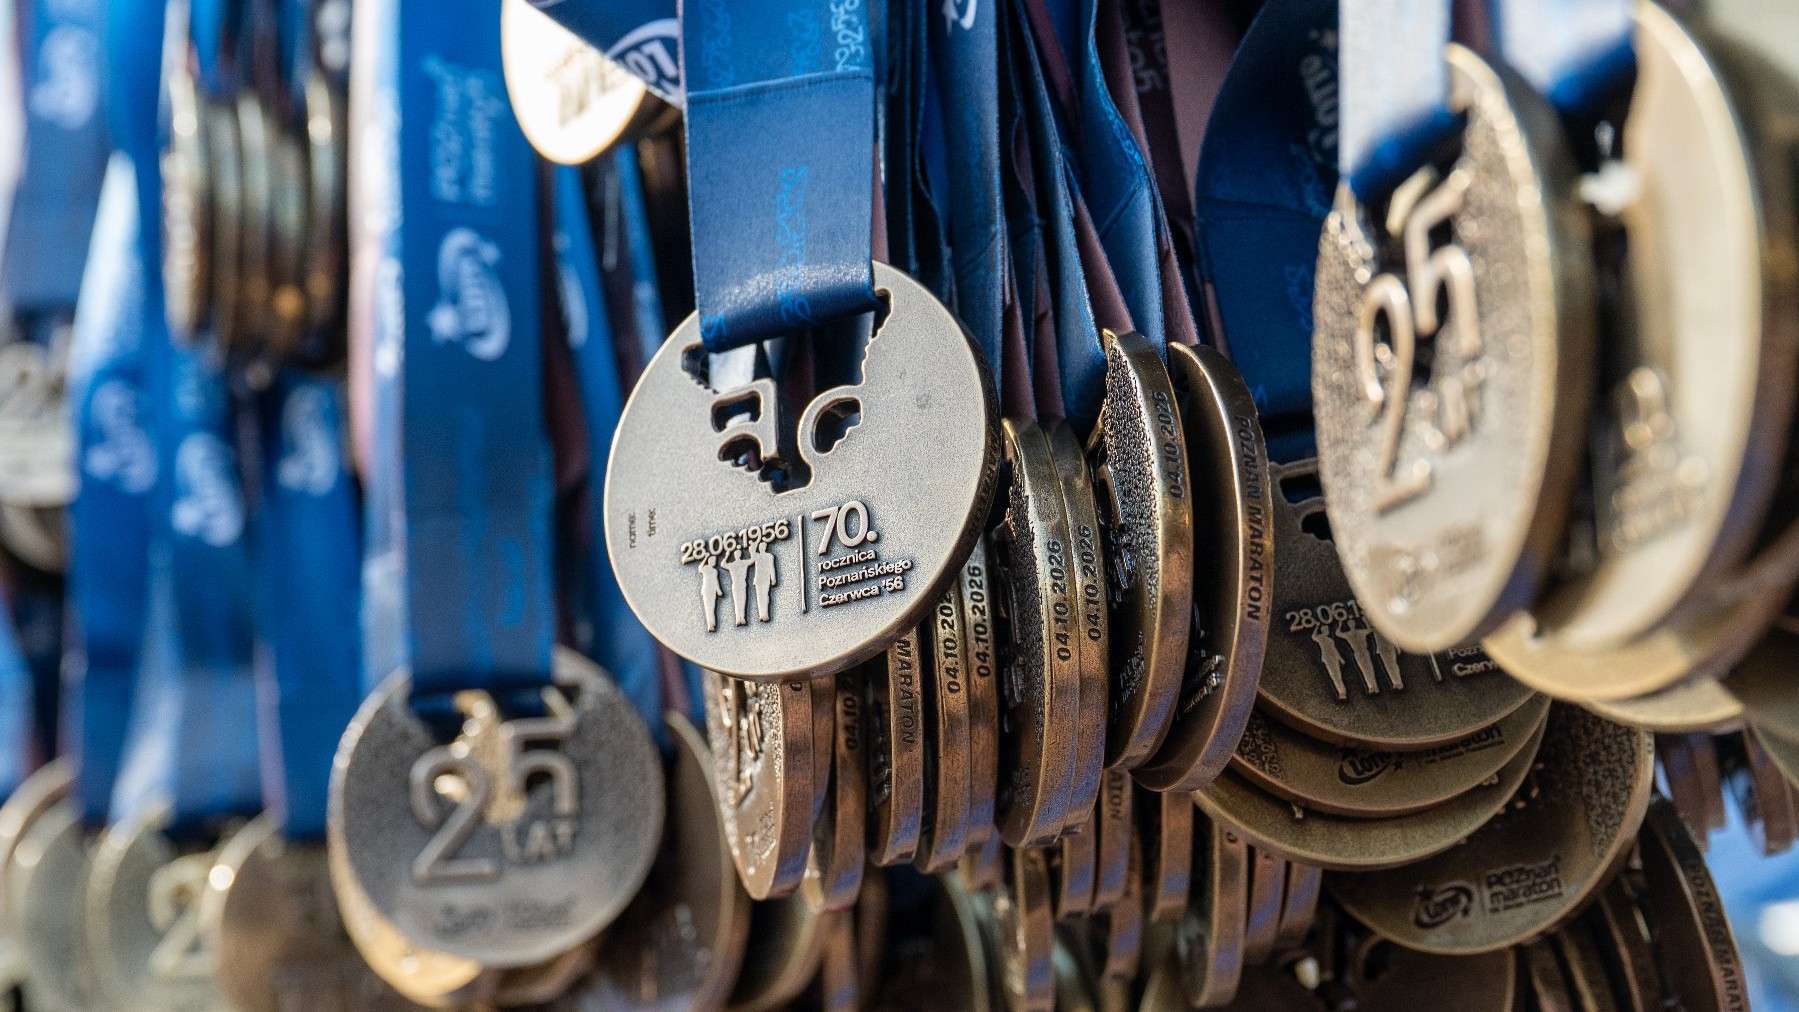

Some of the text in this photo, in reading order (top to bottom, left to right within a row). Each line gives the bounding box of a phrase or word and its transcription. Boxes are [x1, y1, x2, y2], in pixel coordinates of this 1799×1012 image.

[1152, 391, 1184, 499] 04.10.2026
[681, 519, 790, 565] 28.06.1956
[812, 500, 879, 556] 70.
[818, 549, 876, 572] rocznica
[1247, 505, 1264, 620] MARATON
[818, 558, 912, 590] Poznańskiego
[819, 585, 879, 607] Czerwca
[1047, 540, 1071, 661] 04.10.2026
[1079, 525, 1101, 641] 04.10.2026
[967, 565, 991, 678] 04.10.2026
[1286, 599, 1361, 633] 28.06.1
[898, 638, 915, 744] MARATON
